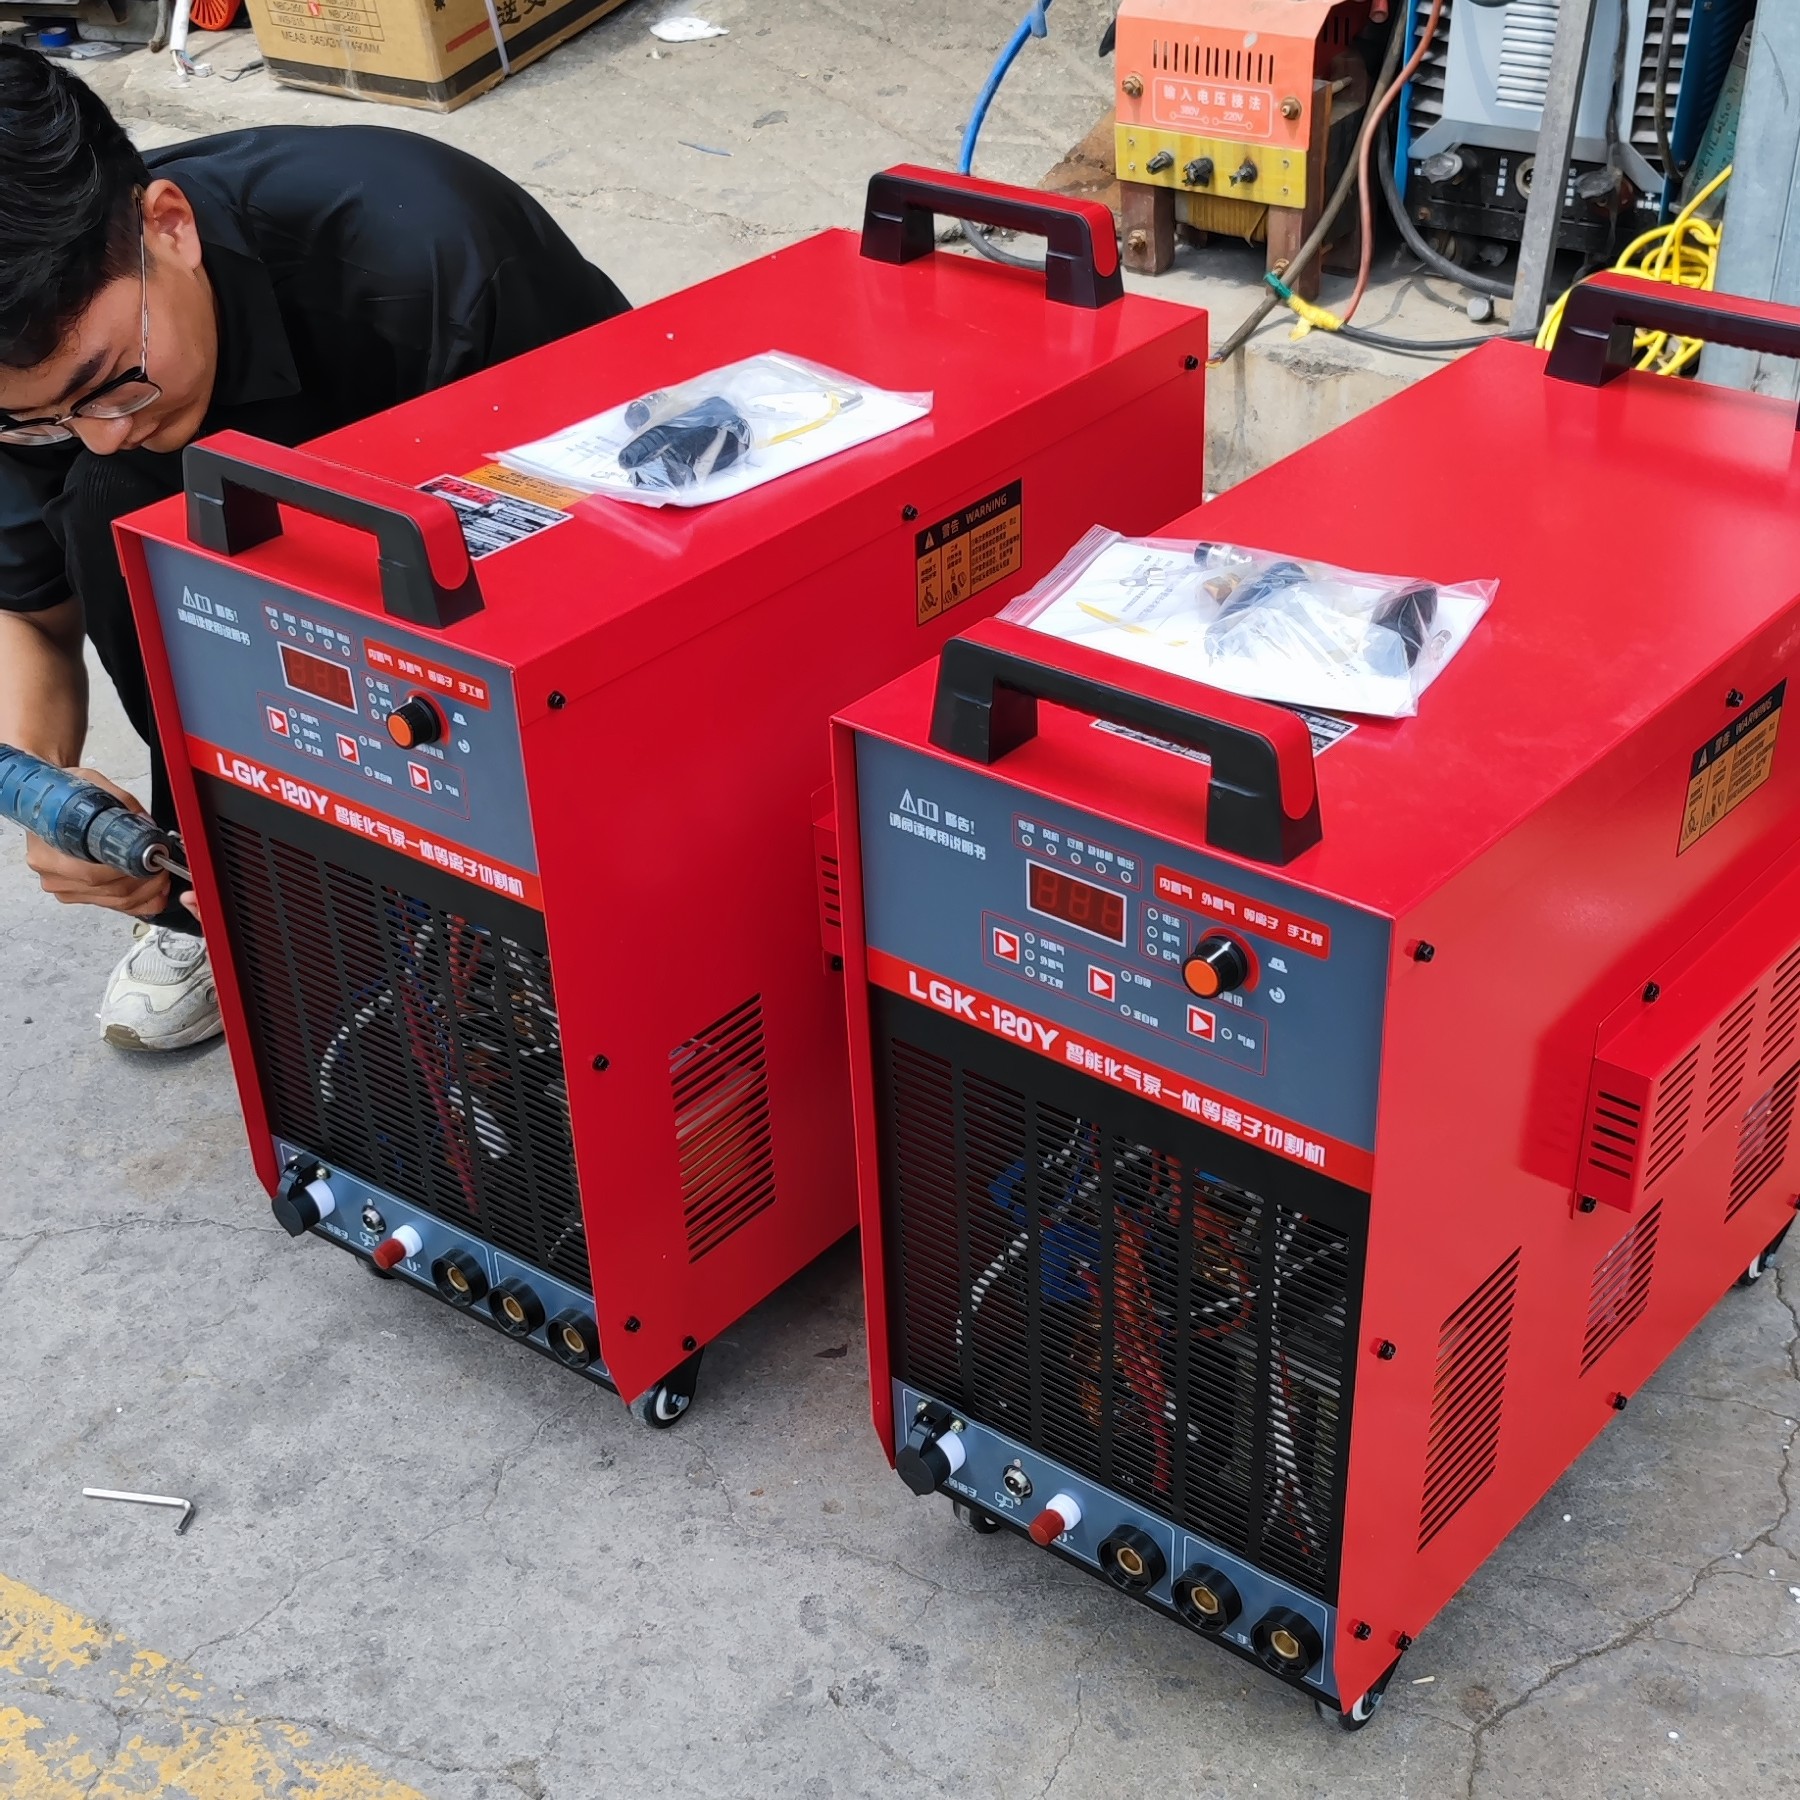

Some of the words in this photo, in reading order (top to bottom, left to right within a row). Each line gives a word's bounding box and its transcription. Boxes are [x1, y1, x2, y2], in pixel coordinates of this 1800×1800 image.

[1163, 84, 1261, 111] 输入电压接法
[1223, 109, 1243, 122] 220V
[965, 493, 1007, 525] WARNING
[177, 608, 251, 646] 请阅读使用说明书
[216, 753, 328, 815] LGK-120Y
[334, 804, 524, 898] 智能化气泵一体等离子切割机
[889, 811, 986, 860] 请阅读使用说明书
[1243, 907, 1279, 930] 等离子
[1287, 923, 1323, 947] 手工焊
[908, 970, 1059, 1051] LGK-120Y
[1066, 1041, 1326, 1168] 智能化气泵一体等离子切割机
